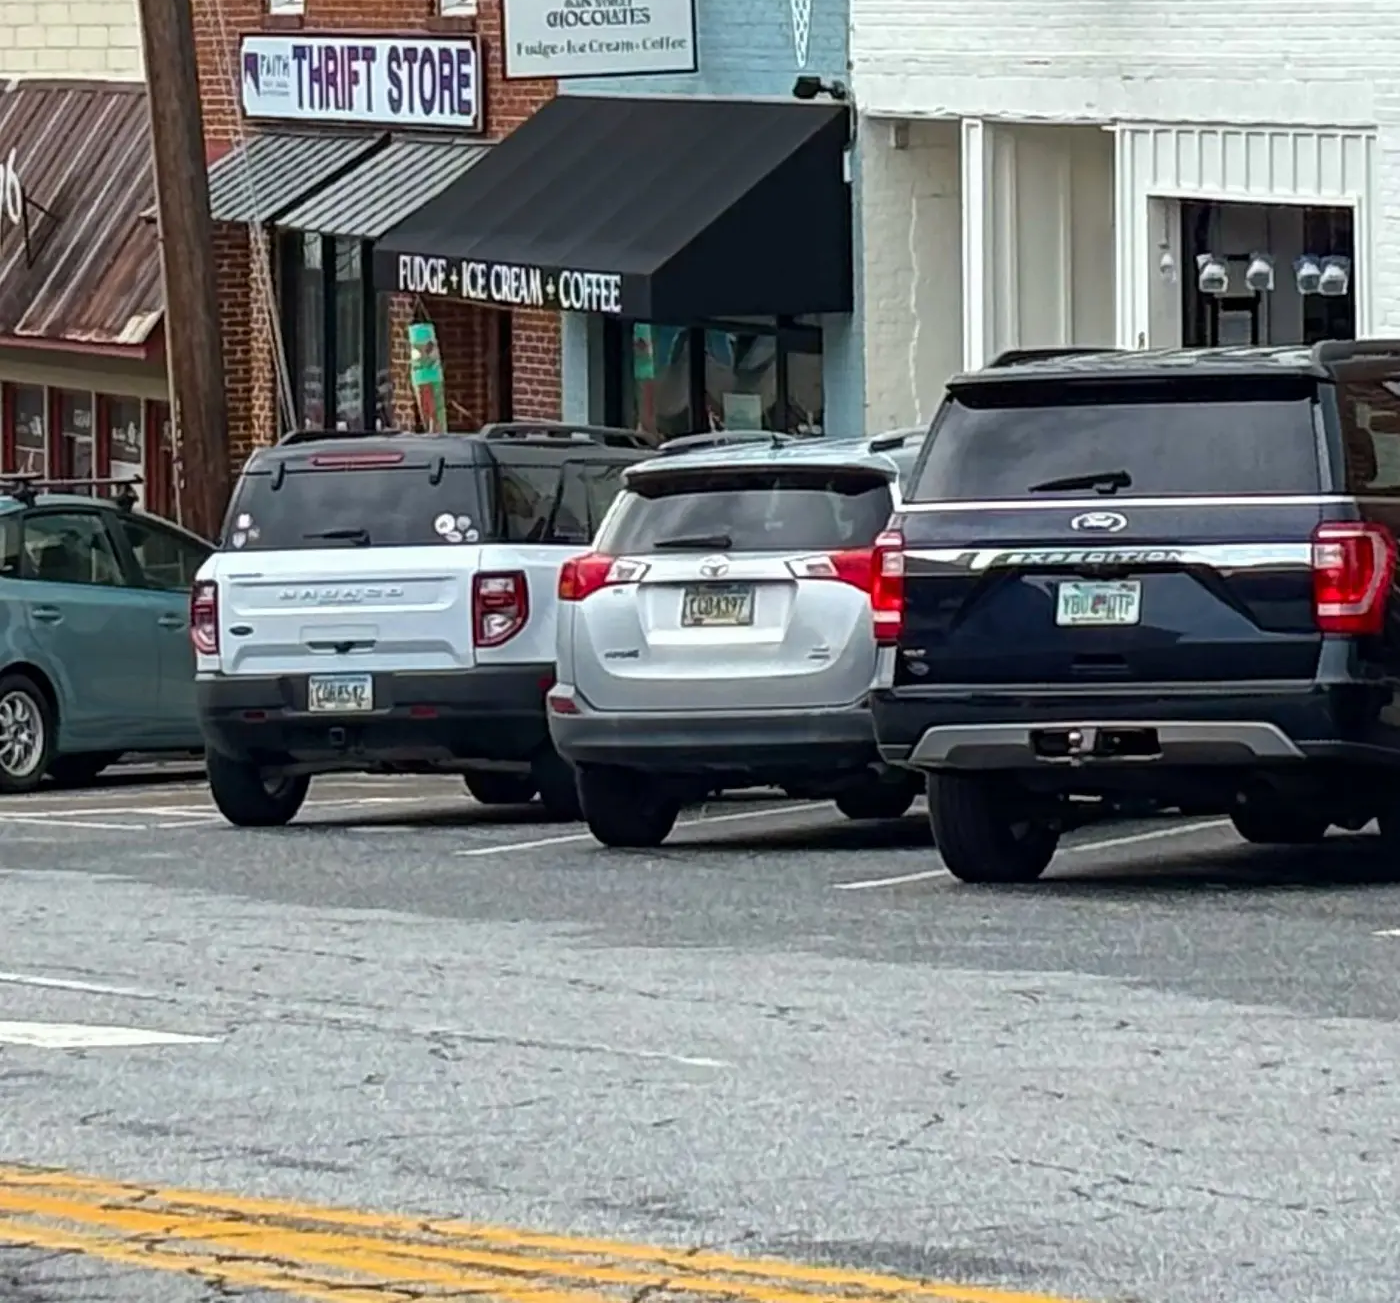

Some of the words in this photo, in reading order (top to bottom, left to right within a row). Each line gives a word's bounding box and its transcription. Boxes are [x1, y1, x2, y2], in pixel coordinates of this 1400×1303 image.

[546, 7, 651, 29] CHOCOLATES
[516, 39, 558, 58] Fudge
[566, 39, 587, 53] Ice
[589, 38, 635, 53] Cream
[642, 35, 688, 51] Coffee
[259, 54, 290, 78] FAITH
[291, 44, 377, 112] THRIFT
[387, 45, 473, 117] STORE
[399, 254, 448, 295] FUDGE
[461, 260, 488, 300] ICE
[490, 264, 544, 306] CREAM
[559, 270, 622, 313] COFFEE
[1006, 549, 1186, 565] EXPEDITION
